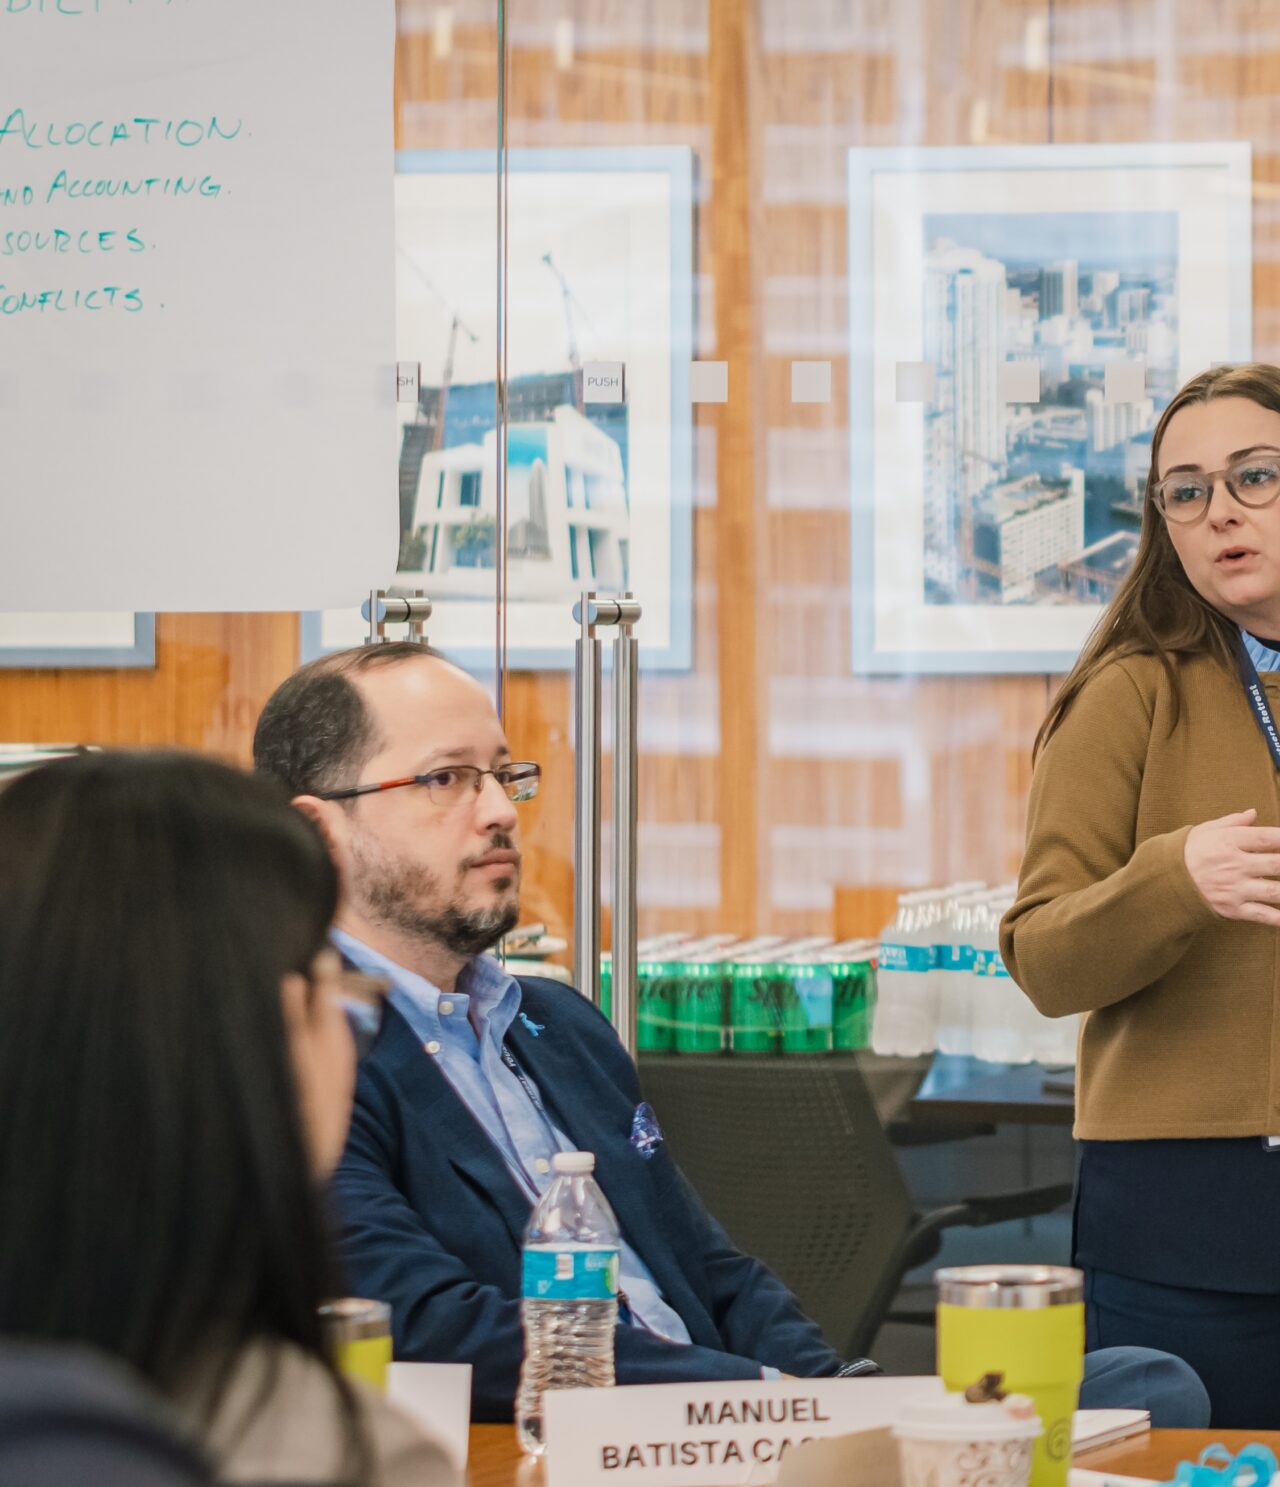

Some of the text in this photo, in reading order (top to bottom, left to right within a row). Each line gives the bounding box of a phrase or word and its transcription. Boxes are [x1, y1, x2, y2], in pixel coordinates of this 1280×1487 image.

[587, 376, 619, 388] PUSH
[1248, 684, 1272, 725] Retreat
[685, 1396, 831, 1426] MANUEL
[601, 1439, 745, 1470] BATISTA
